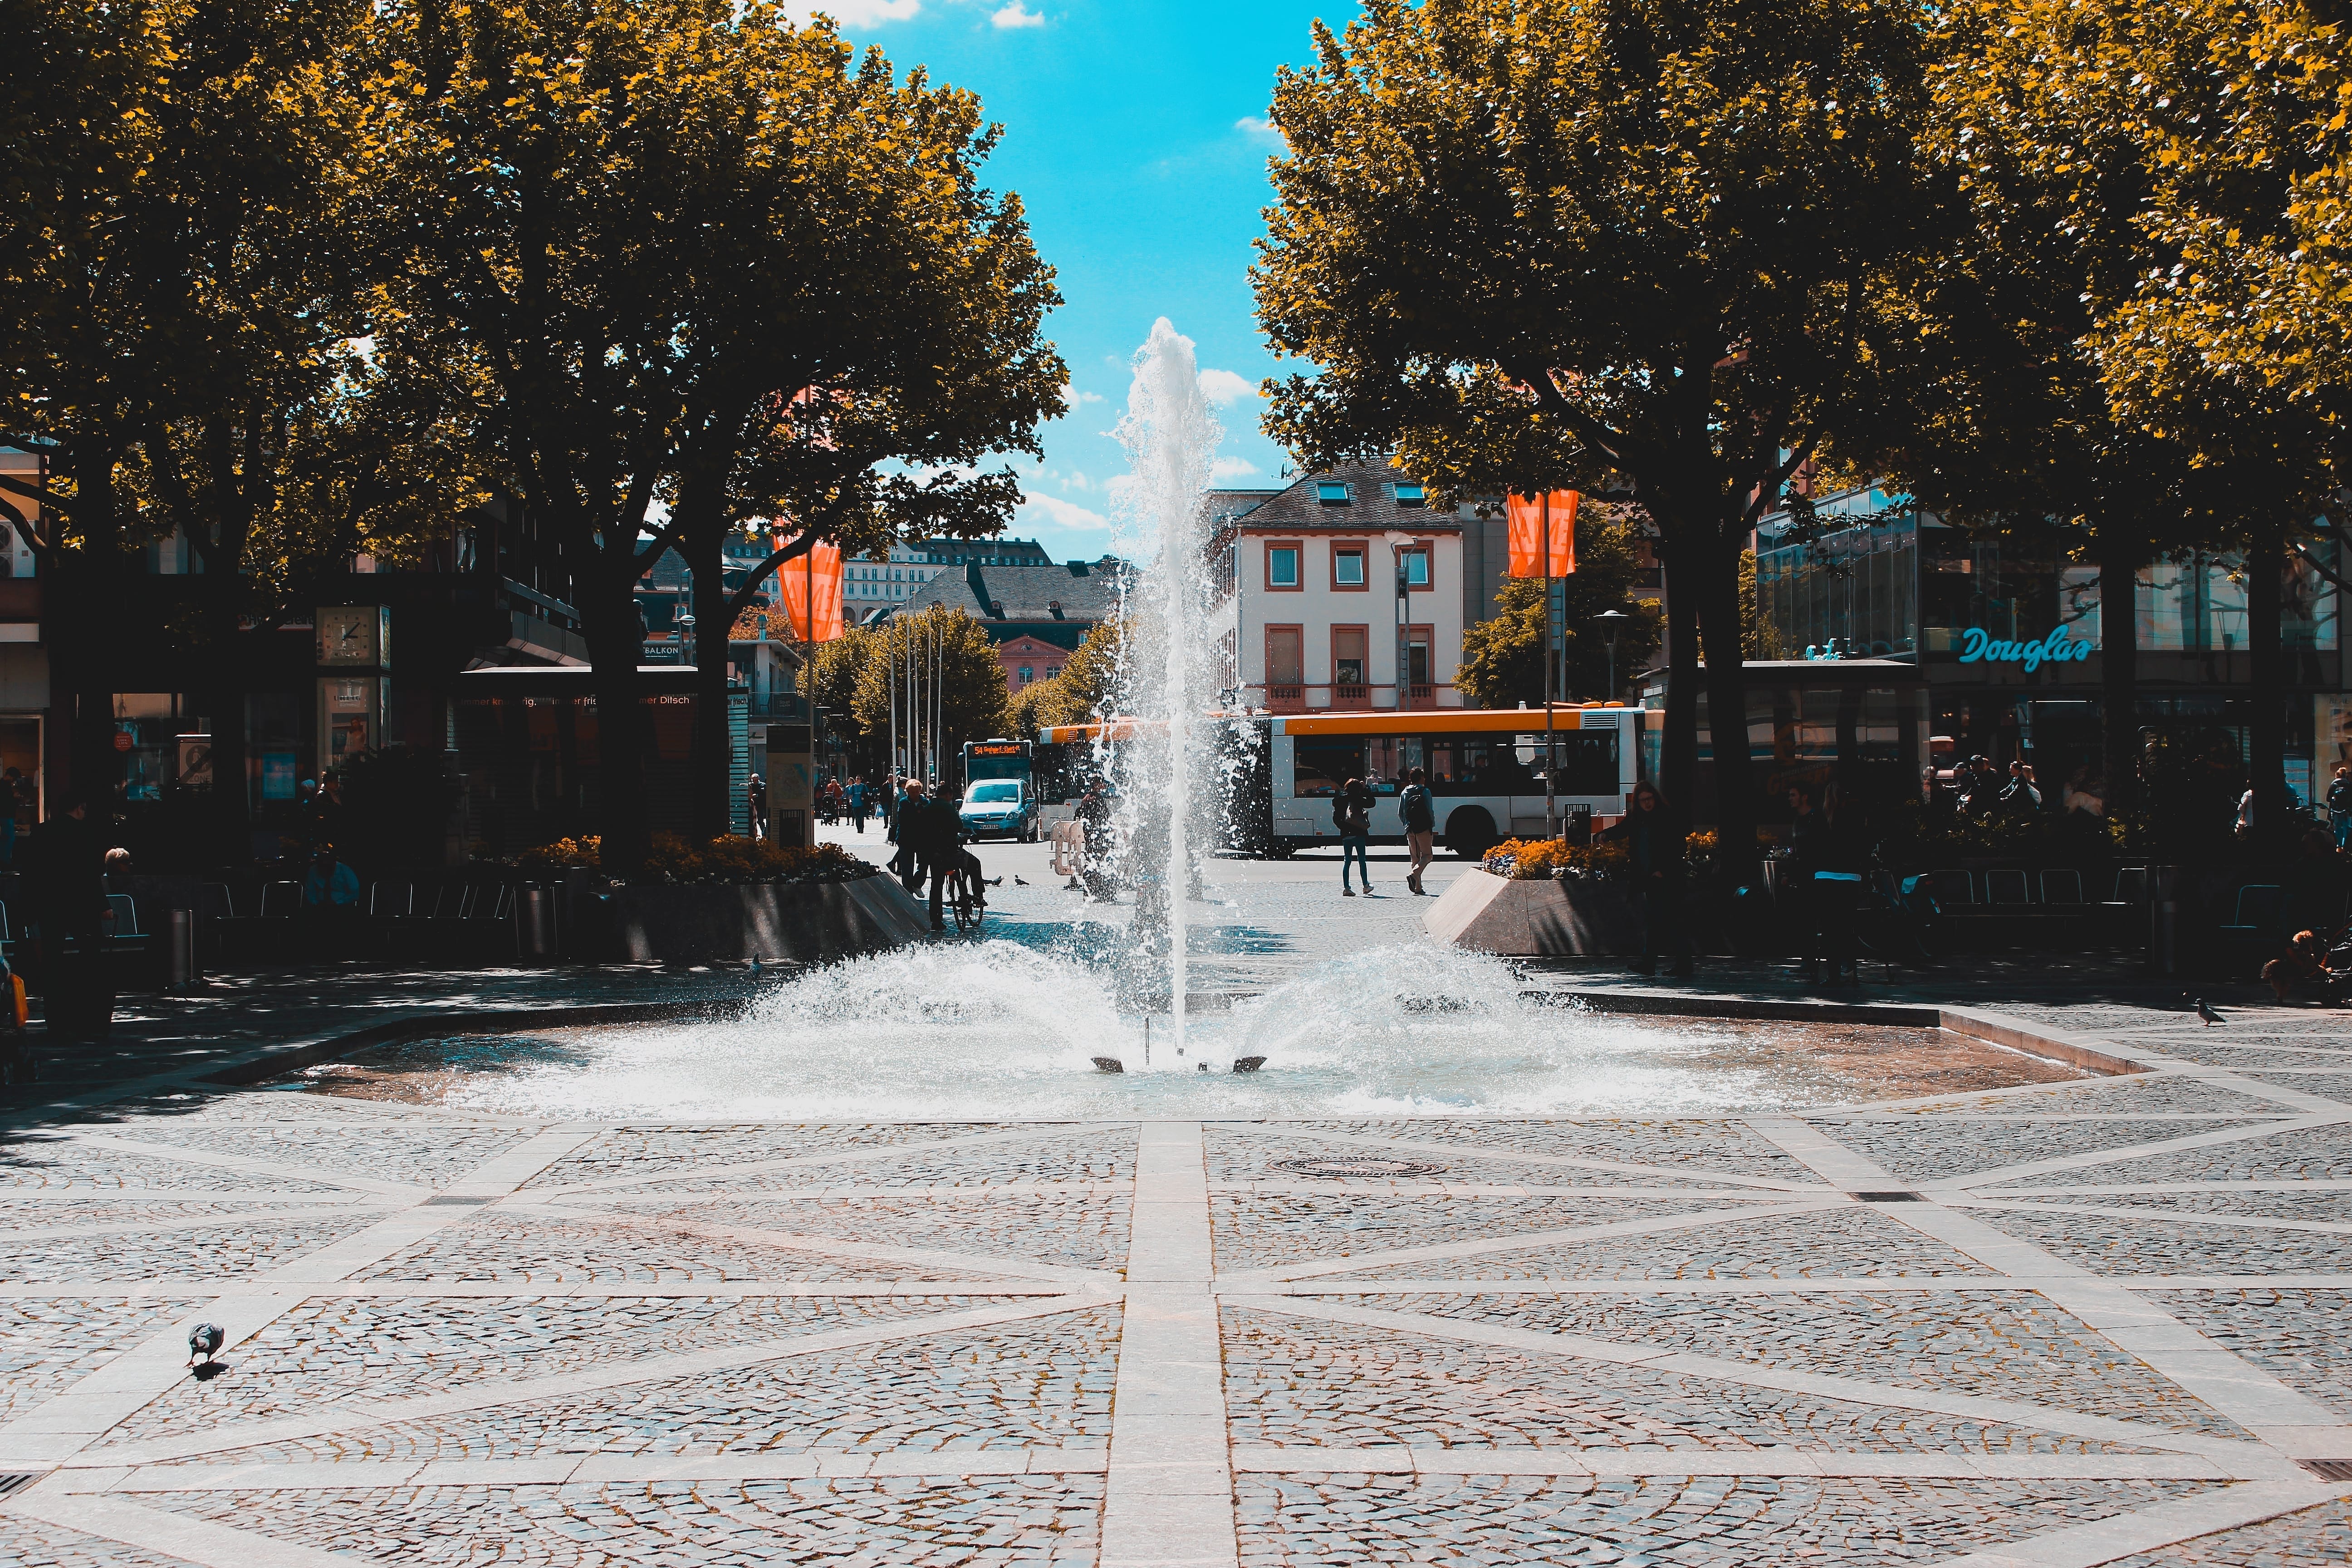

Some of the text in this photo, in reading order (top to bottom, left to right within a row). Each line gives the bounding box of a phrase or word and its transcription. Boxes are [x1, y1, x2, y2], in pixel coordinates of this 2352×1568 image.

[1959, 624, 2092, 673] Douglas
[660, 696, 690, 704] Ditsch
[974, 746, 983, 755] 54
